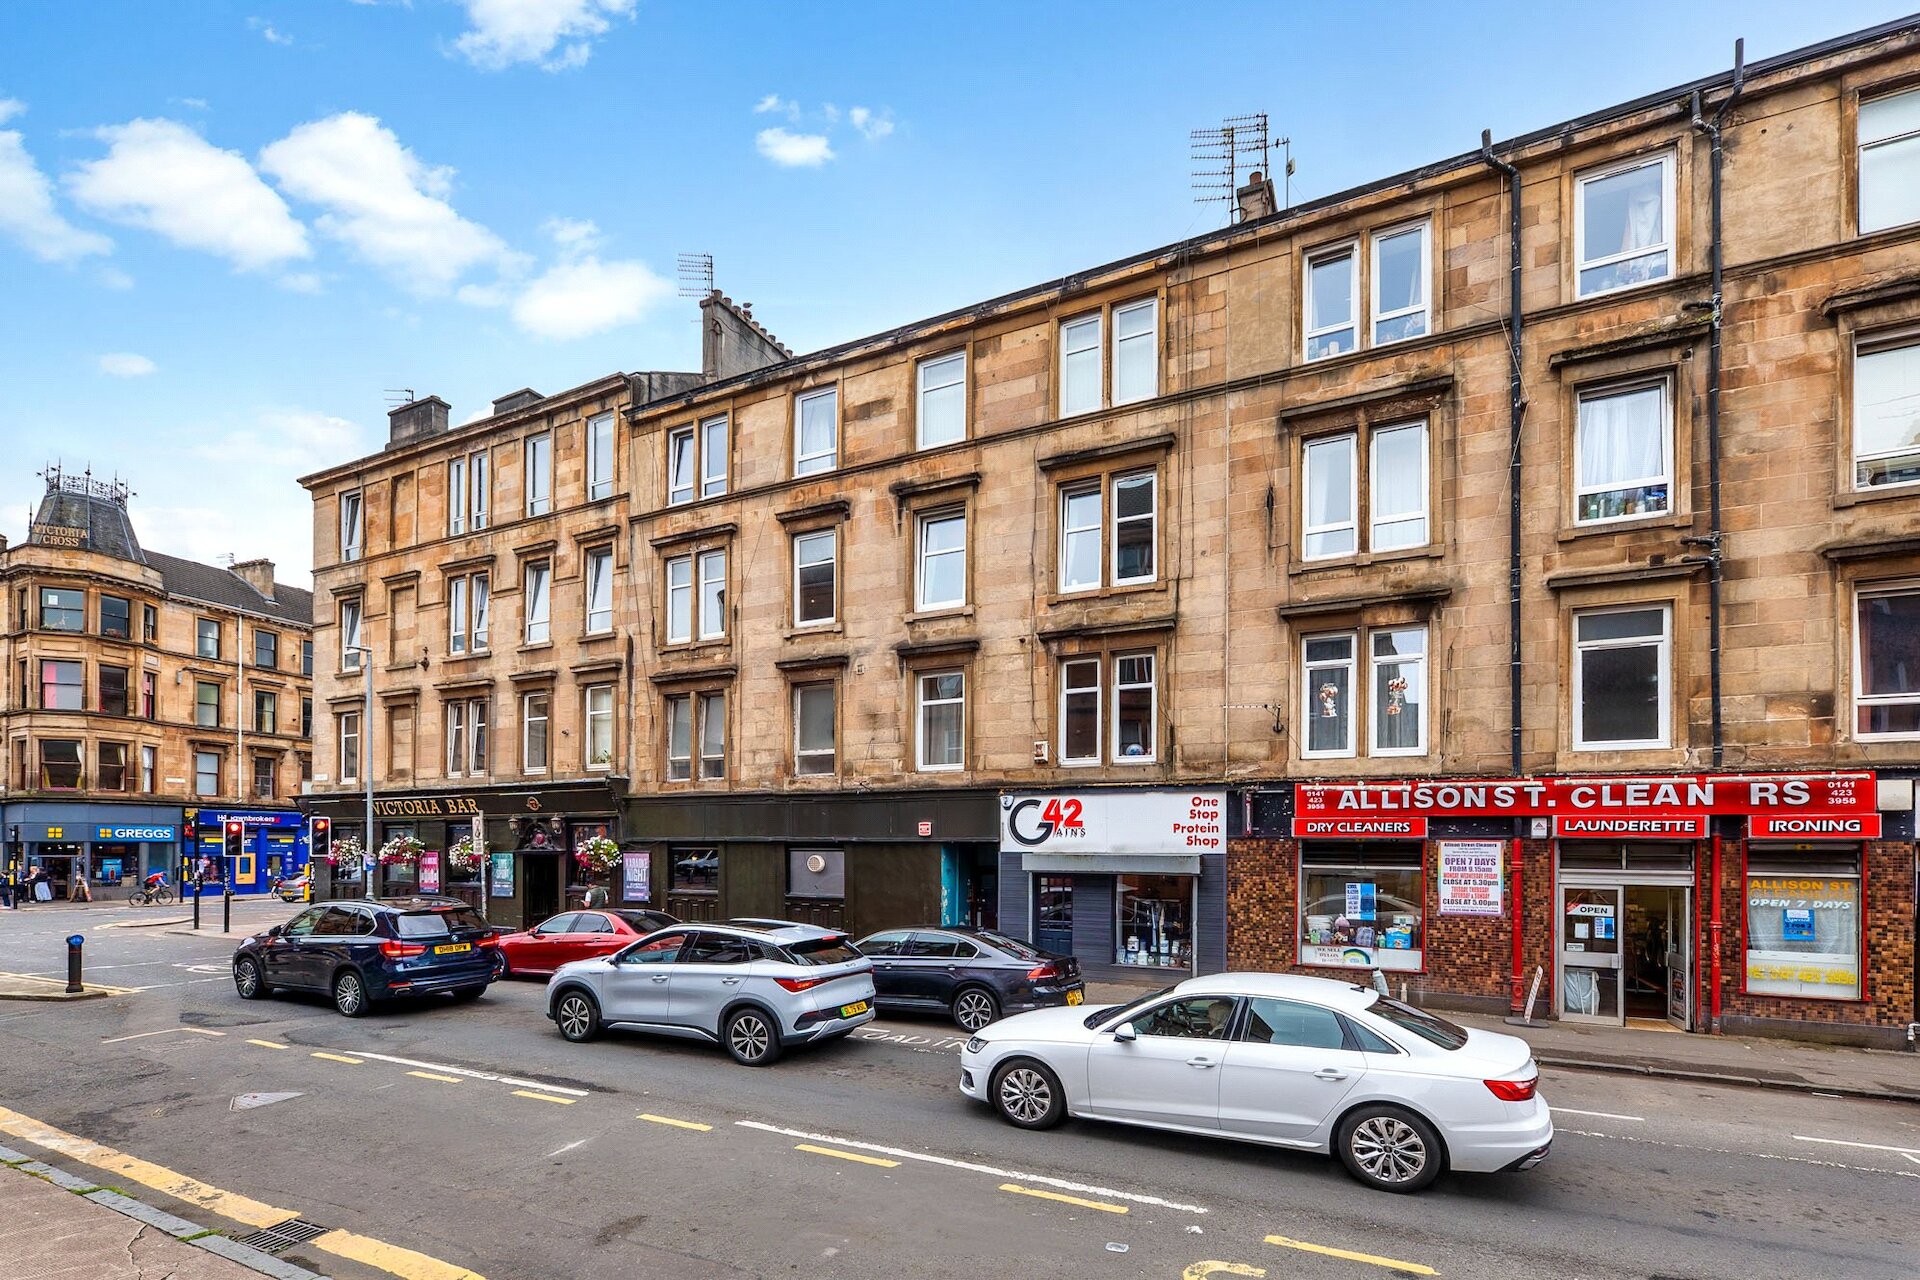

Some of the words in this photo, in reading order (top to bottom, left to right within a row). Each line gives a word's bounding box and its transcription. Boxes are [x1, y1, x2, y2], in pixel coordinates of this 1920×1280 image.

[33, 524, 88, 538] VICTORIA
[42, 534, 79, 547] CROSS
[1827, 781, 1856, 789] 0141
[1830, 789, 1853, 797] 423
[1191, 796, 1219, 807] One
[1827, 797, 1857, 805] 3958
[372, 800, 442, 816] VICTORIA
[445, 798, 480, 814] BAR
[1189, 809, 1219, 822] Stop
[1173, 822, 1219, 834] Protein
[1307, 822, 1334, 833] DRY
[1337, 822, 1411, 833] CLEANERS
[1565, 820, 1696, 832] LAUNDERETTE
[1768, 820, 1861, 832] IRONING
[114, 828, 171, 839] GREGGS
[1186, 834, 1219, 849] Shop
[1444, 857, 1467, 866] OPEN
[1467, 857, 1474, 867] 7
[1474, 857, 1497, 866] DAYS
[626, 868, 647, 881] NIGHT
[1472, 879, 1499, 887] 5.30pm
[1750, 880, 1824, 890] ALLISON
[1829, 882, 1851, 890] ST
[1750, 899, 1790, 907] OPEN
[1796, 900, 1807, 908] 7
[1812, 900, 1853, 909] DAYS
[1580, 906, 1608, 914] OPEN
